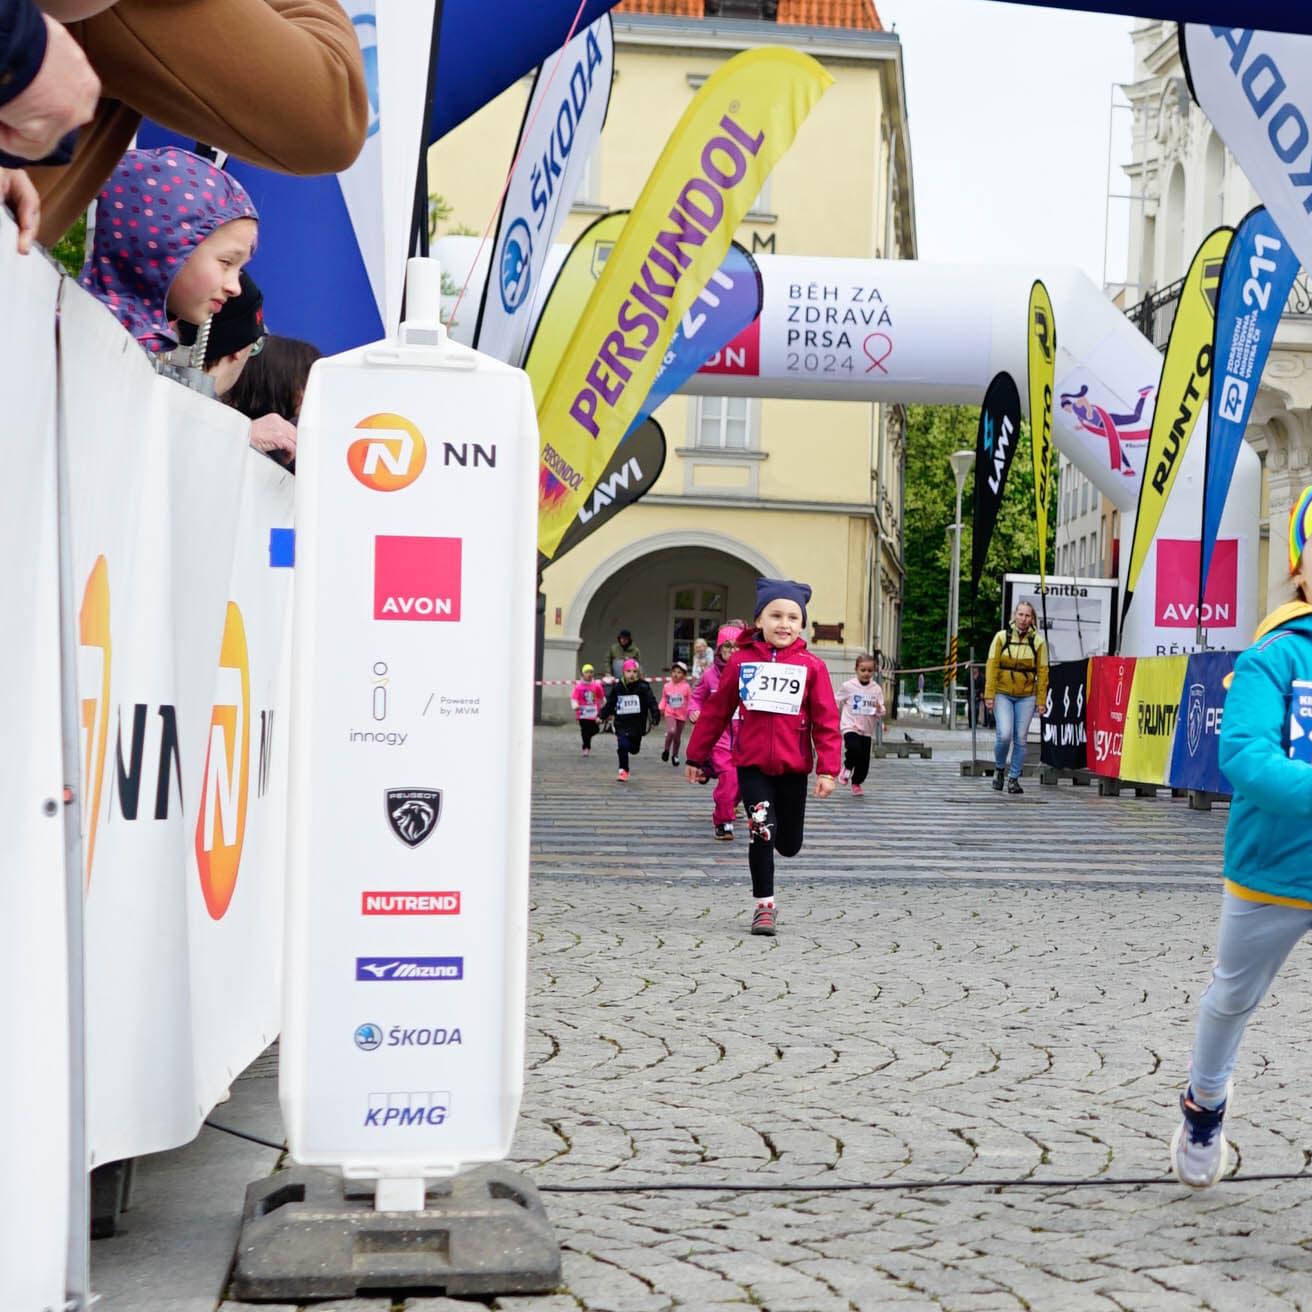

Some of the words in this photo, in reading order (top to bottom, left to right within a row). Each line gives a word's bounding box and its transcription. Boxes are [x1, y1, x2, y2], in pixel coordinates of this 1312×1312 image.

[530, 25, 603, 233] ŠKODA
[569, 114, 765, 440] PERSKINDOL
[1243, 233, 1281, 311] 211
[789, 282, 838, 301] BĚH
[851, 287, 883, 303] ZA
[787, 305, 893, 327] ZDRAVÁ
[787, 329, 852, 349] PRSA
[787, 352, 855, 373] 2024
[1152, 343, 1212, 496] RUNTO
[443, 442, 497, 468] NN
[988, 415, 1014, 496] LAWI
[578, 456, 643, 525] LAWI
[381, 597, 451, 614] AVON
[1163, 603, 1230, 621] AVON
[759, 675, 801, 694] 3179
[440, 696, 480, 705] Powered
[440, 707, 452, 716] by
[349, 728, 408, 746] innogy
[389, 792, 438, 800] PEUGEOT
[366, 896, 457, 911] NUTREND
[386, 1025, 463, 1047] ŠKODA
[364, 1105, 447, 1127] KPMG
